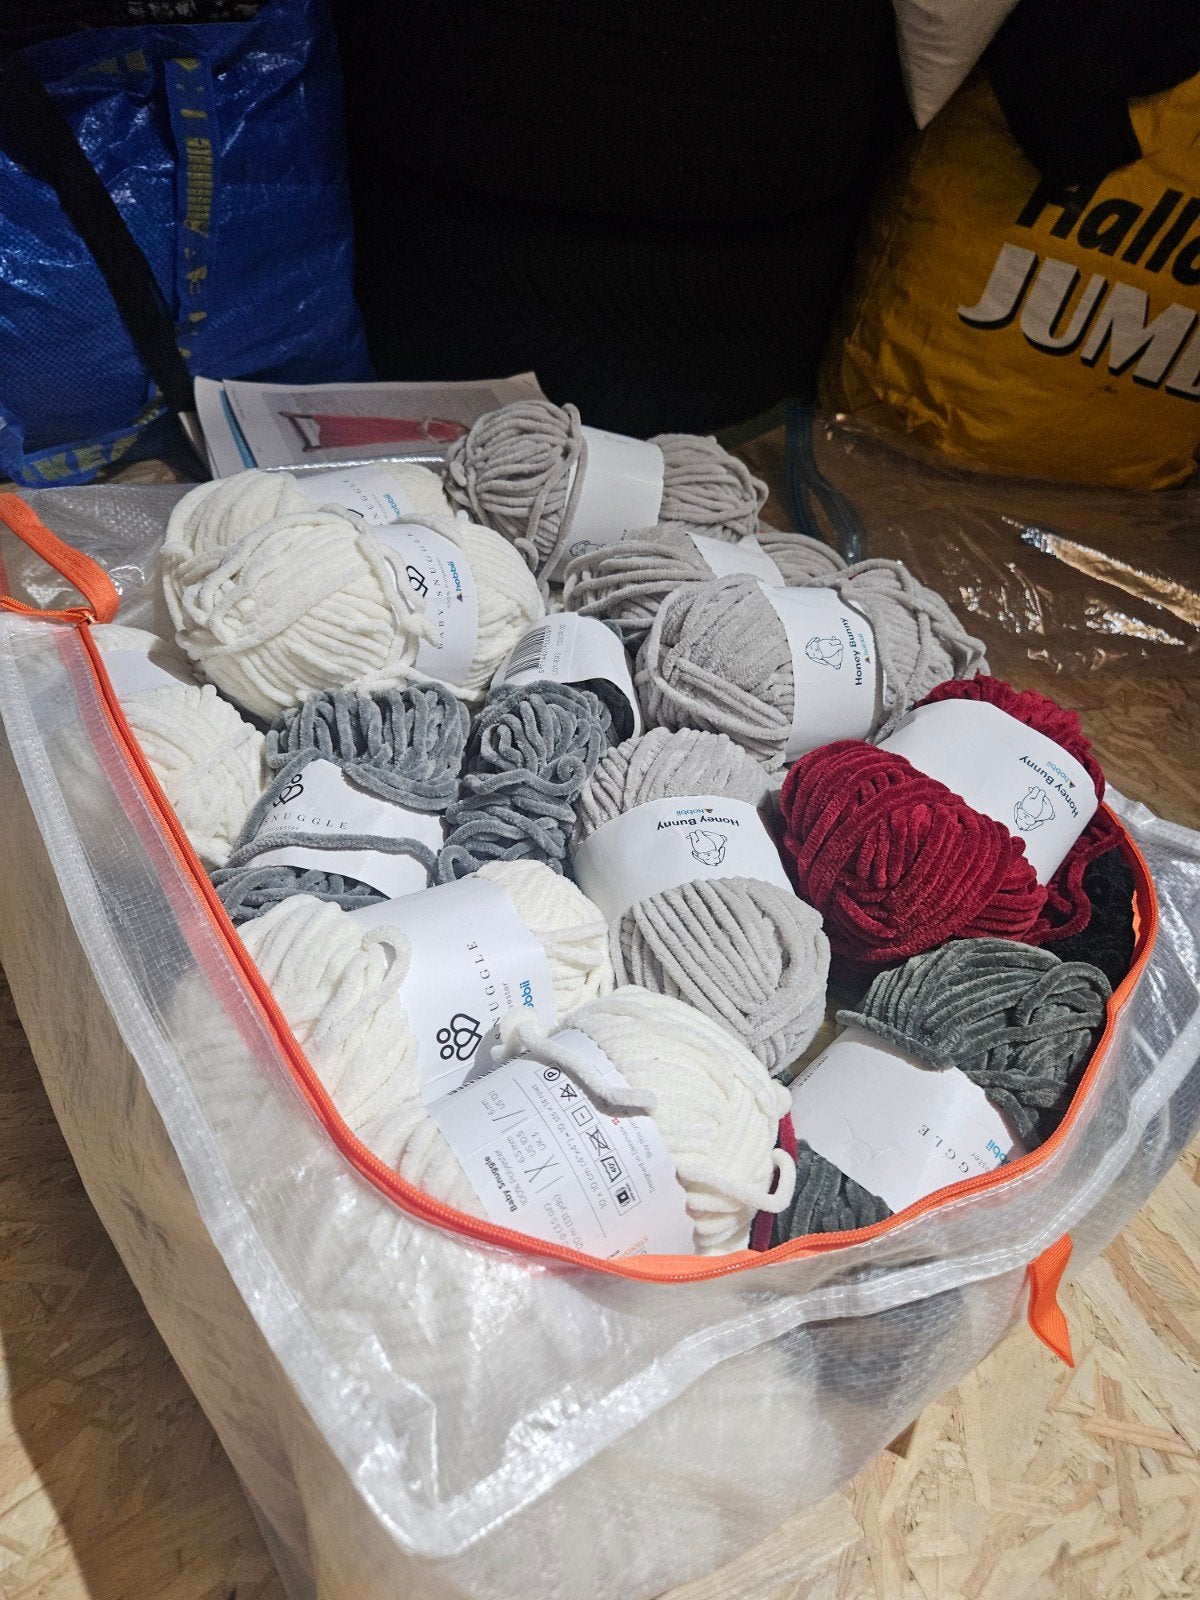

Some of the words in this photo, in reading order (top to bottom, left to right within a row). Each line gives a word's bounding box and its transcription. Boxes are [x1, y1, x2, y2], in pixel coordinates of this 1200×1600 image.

[446, 560, 463, 592] hobbii
[840, 617, 857, 648] Bunny
[853, 650, 863, 686] Honey
[1019, 755, 1055, 786] Bunny
[1045, 760, 1070, 783] hobbii
[1054, 782, 1079, 818] Honey
[656, 818, 697, 831] Bunny
[699, 815, 740, 827] Honey
[519, 979, 535, 1008] bbii
[918, 1124, 969, 1173] GGLE
[484, 1156, 506, 1189] Snuggle
[503, 1190, 518, 1212] Baby
